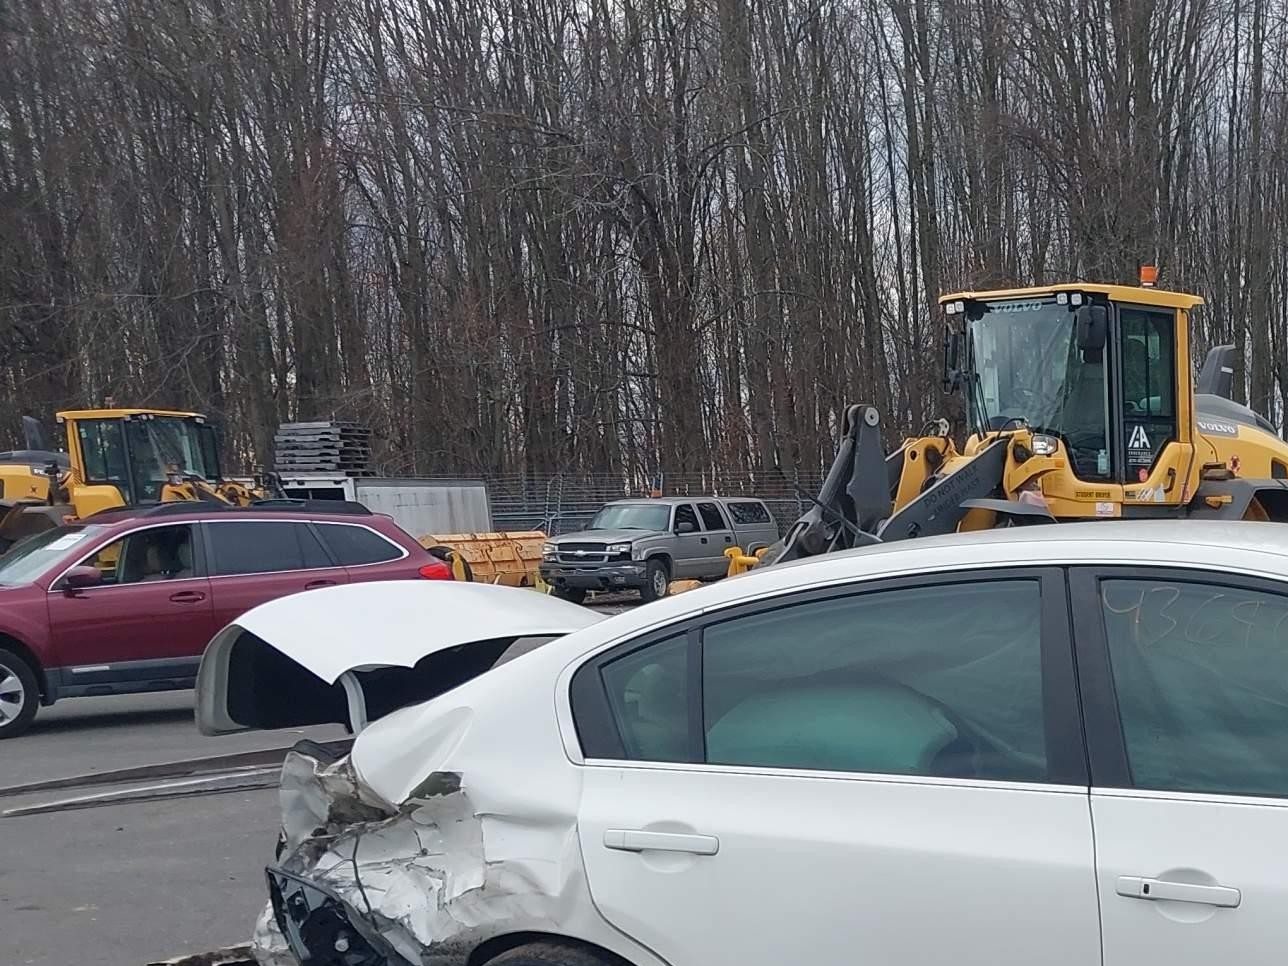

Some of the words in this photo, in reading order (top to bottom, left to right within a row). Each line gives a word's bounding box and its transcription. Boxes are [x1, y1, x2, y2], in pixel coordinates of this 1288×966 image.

[991, 301, 1042, 313] VOLVO
[1197, 421, 1236, 434] VOLVO
[937, 480, 957, 498] NOT
